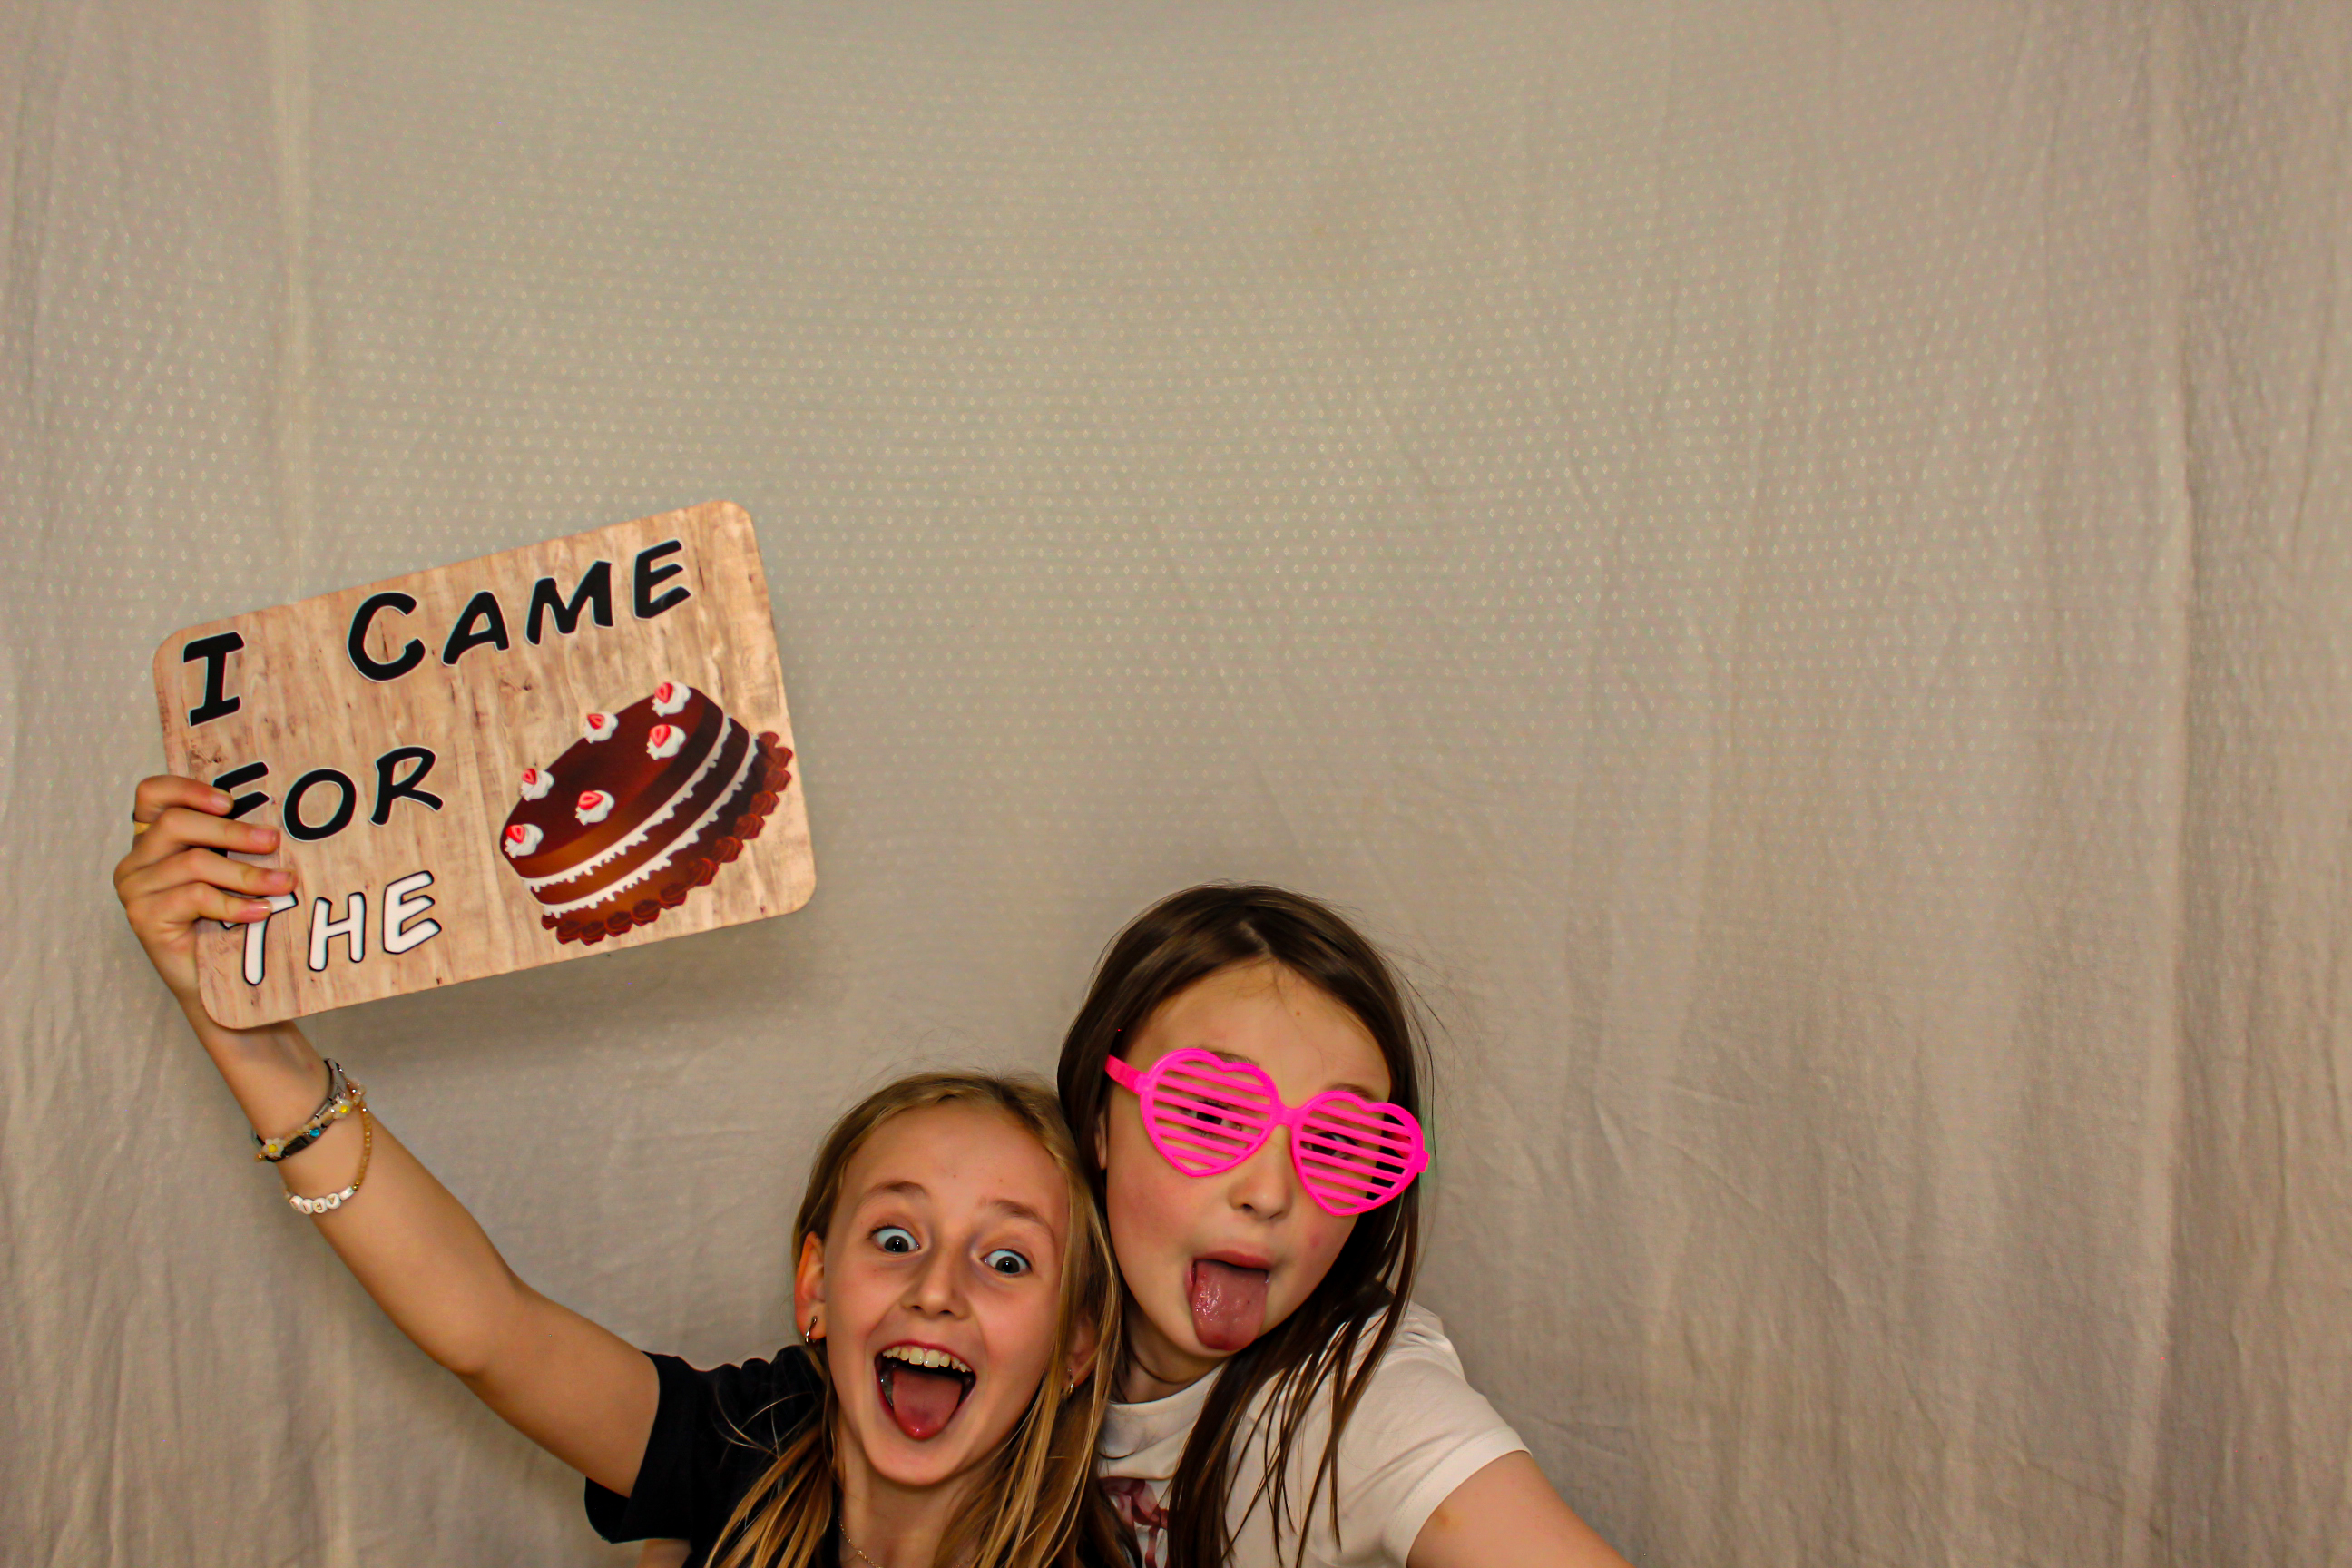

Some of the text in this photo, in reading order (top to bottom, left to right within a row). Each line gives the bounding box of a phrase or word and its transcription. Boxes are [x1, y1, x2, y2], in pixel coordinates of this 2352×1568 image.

[182, 539, 692, 727] I CAME
[218, 869, 443, 986] THE
